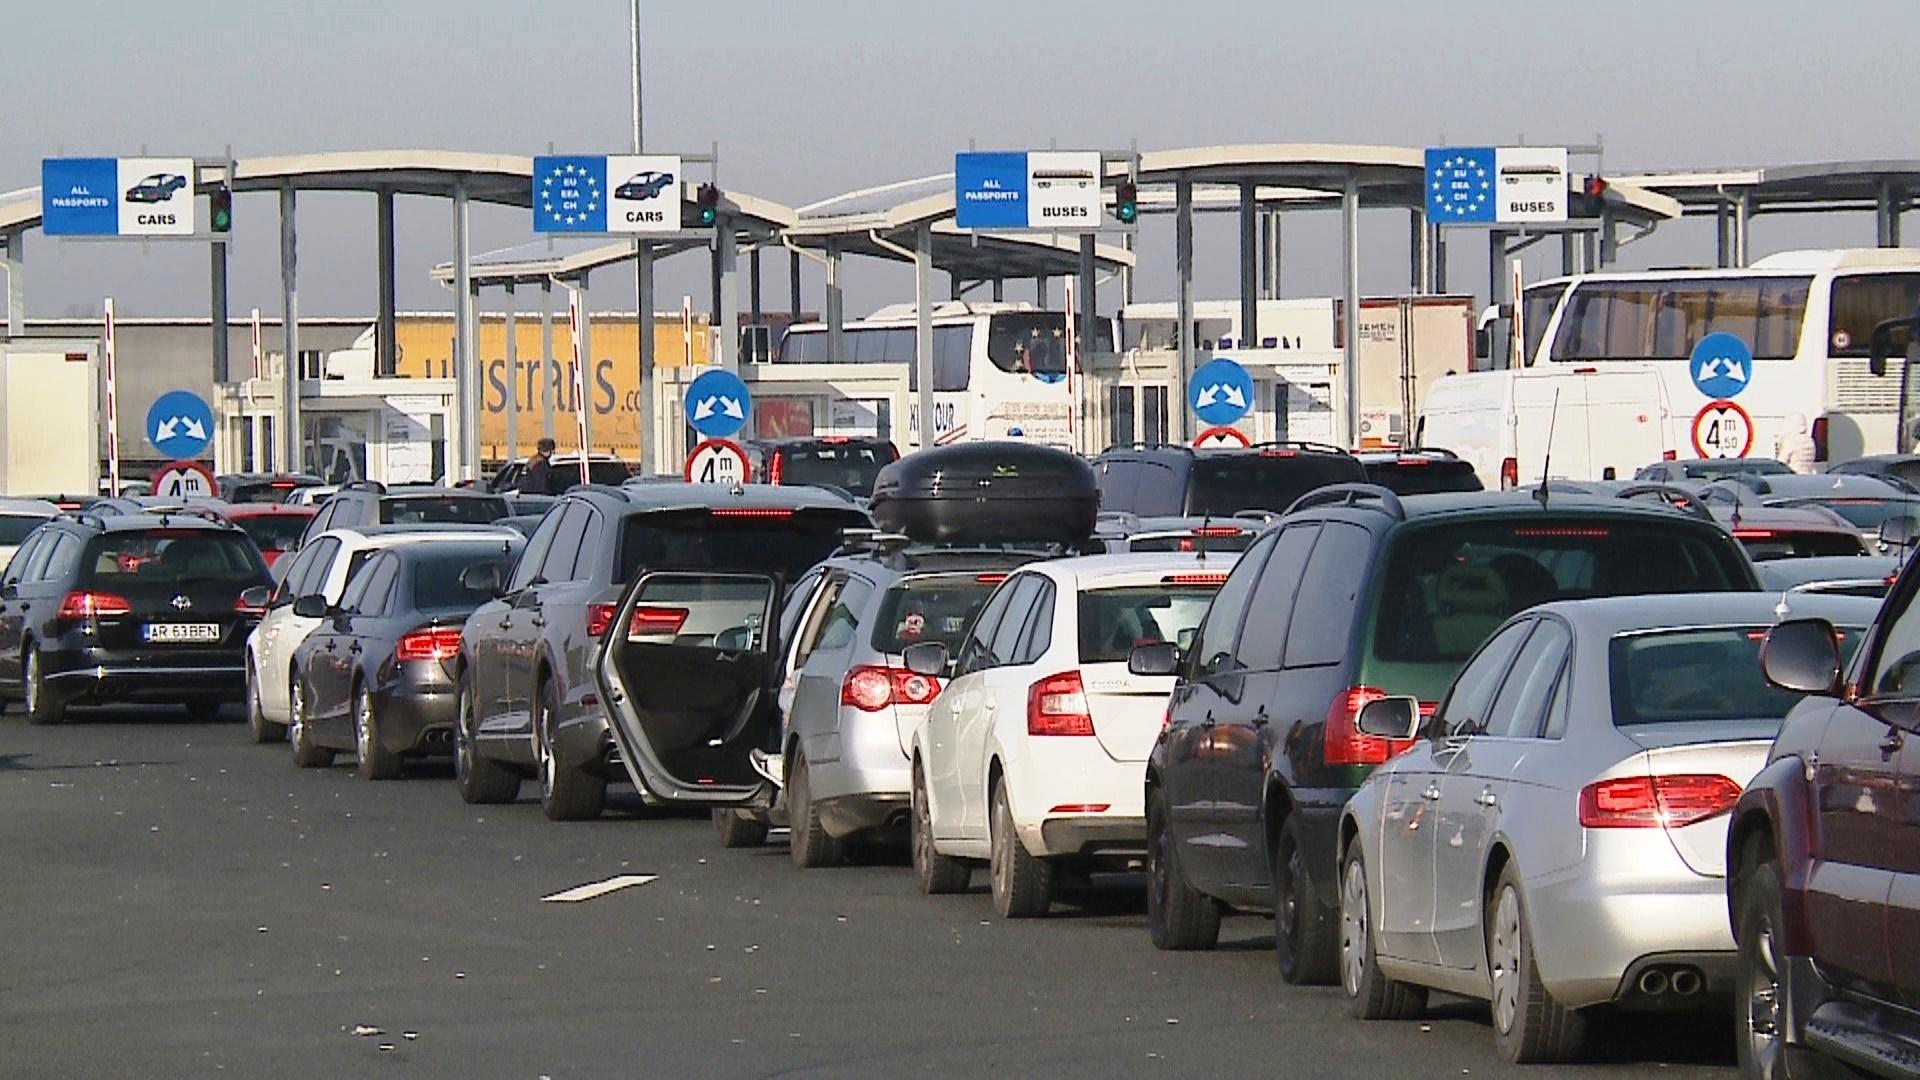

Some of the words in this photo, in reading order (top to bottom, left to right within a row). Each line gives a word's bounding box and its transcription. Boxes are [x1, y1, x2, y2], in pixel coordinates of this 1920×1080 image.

[1454, 169, 1467, 178] EU
[563, 178, 577, 187] EU
[982, 179, 1001, 189] ALL
[71, 186, 89, 195] ALL
[561, 189, 580, 198] EEA
[965, 191, 1019, 201] PASSPORTS
[1454, 193, 1468, 201] CH
[52, 198, 109, 207] PASSPORTS
[563, 201, 578, 210] CH
[1510, 202, 1555, 213] BUSES
[626, 211, 663, 223] CARS
[1042, 207, 1088, 217] BUSES
[137, 214, 176, 226] CARS
[1706, 419, 1720, 449] 4
[1724, 419, 1737, 431] m
[720, 457, 732, 471] m
